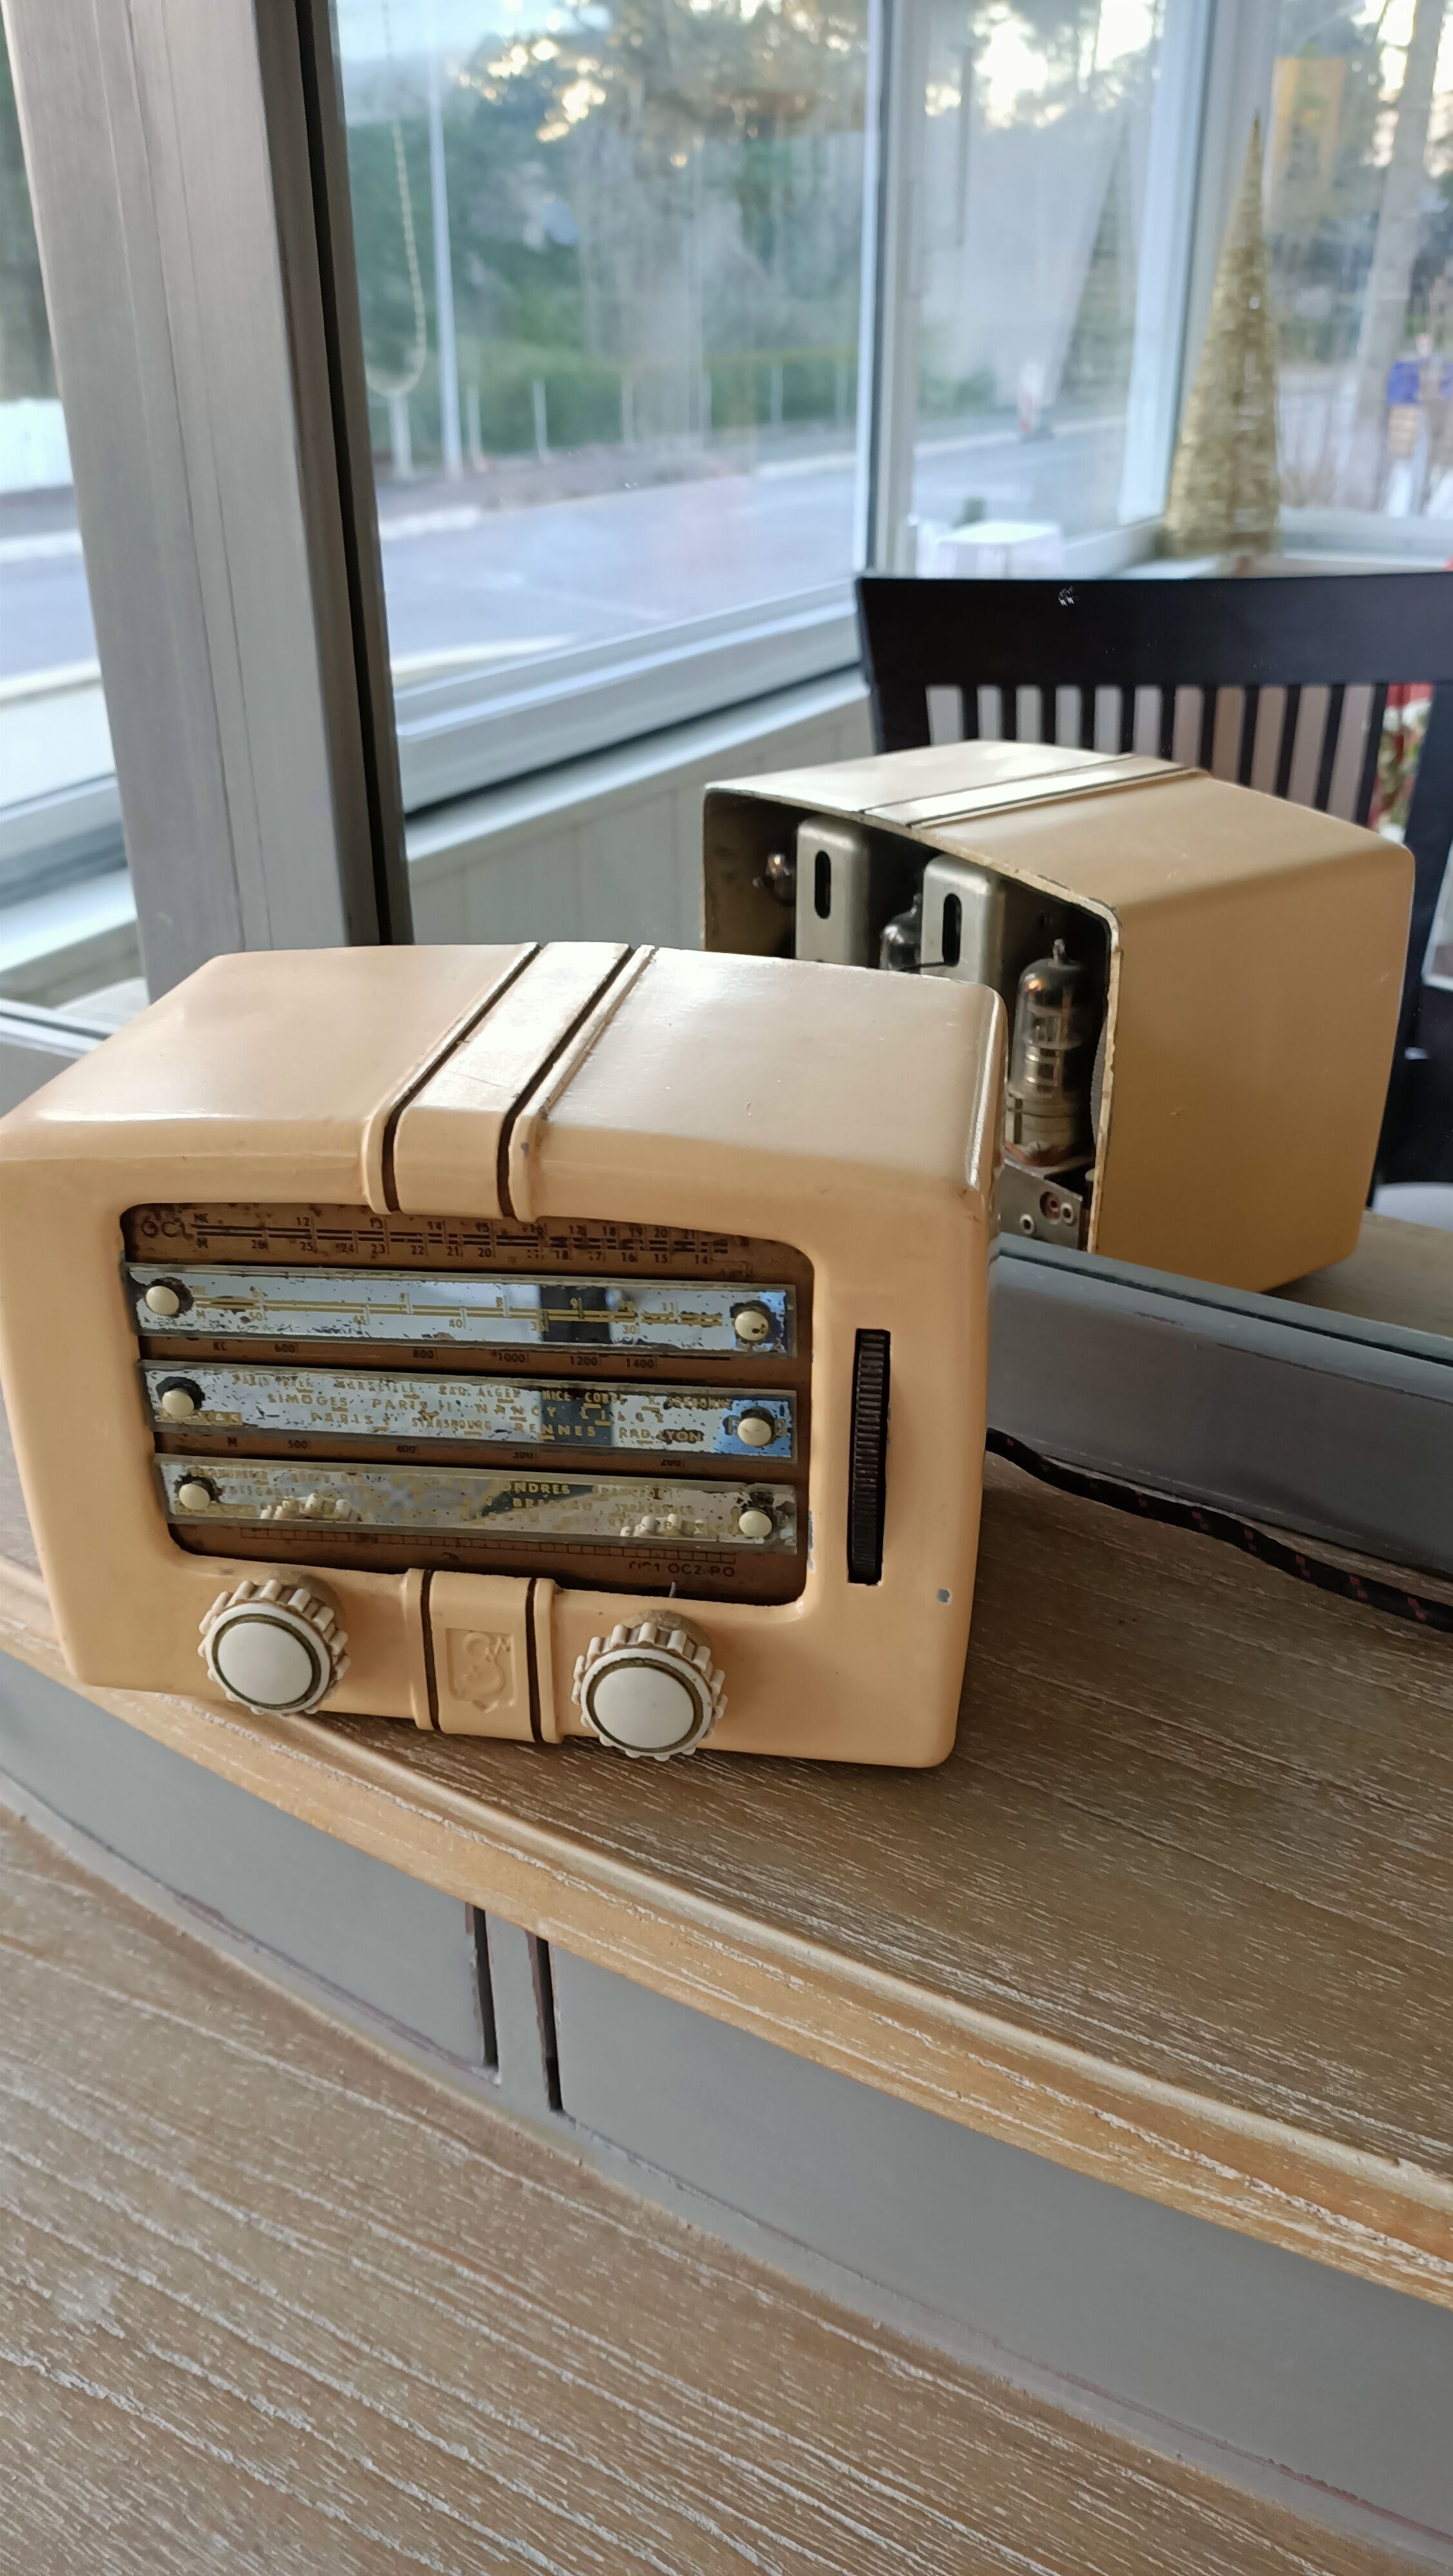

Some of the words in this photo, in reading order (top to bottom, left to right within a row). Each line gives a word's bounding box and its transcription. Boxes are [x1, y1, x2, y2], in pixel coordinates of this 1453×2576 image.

[602, 1226, 616, 1236] 18
[654, 1227, 667, 1238] 20
[683, 1229, 696, 1240] 21
[300, 1242, 314, 1251] 25
[371, 1244, 386, 1254] 23
[410, 1245, 424, 1255] 22
[447, 1246, 459, 1256] 21
[478, 1247, 492, 1257] 20
[654, 1254, 668, 1264] 15
[696, 1255, 708, 1264] 14
[661, 1302, 675, 1311] 11
[449, 1320, 463, 1329] 40
[622, 1325, 636, 1334] 30
[274, 1344, 296, 1353] 600
[413, 1350, 435, 1359] 800
[499, 1353, 526, 1363] 1000
[571, 1356, 598, 1366] 1200
[626, 1358, 654, 1369] 1400
[268, 1393, 348, 1407] LIMOGES
[515, 1423, 596, 1437] RENNES
[619, 1427, 651, 1439] RAD
[657, 1430, 702, 1442] LYON
[667, 1562, 703, 1575] OC2
[710, 1565, 736, 1577] PO
